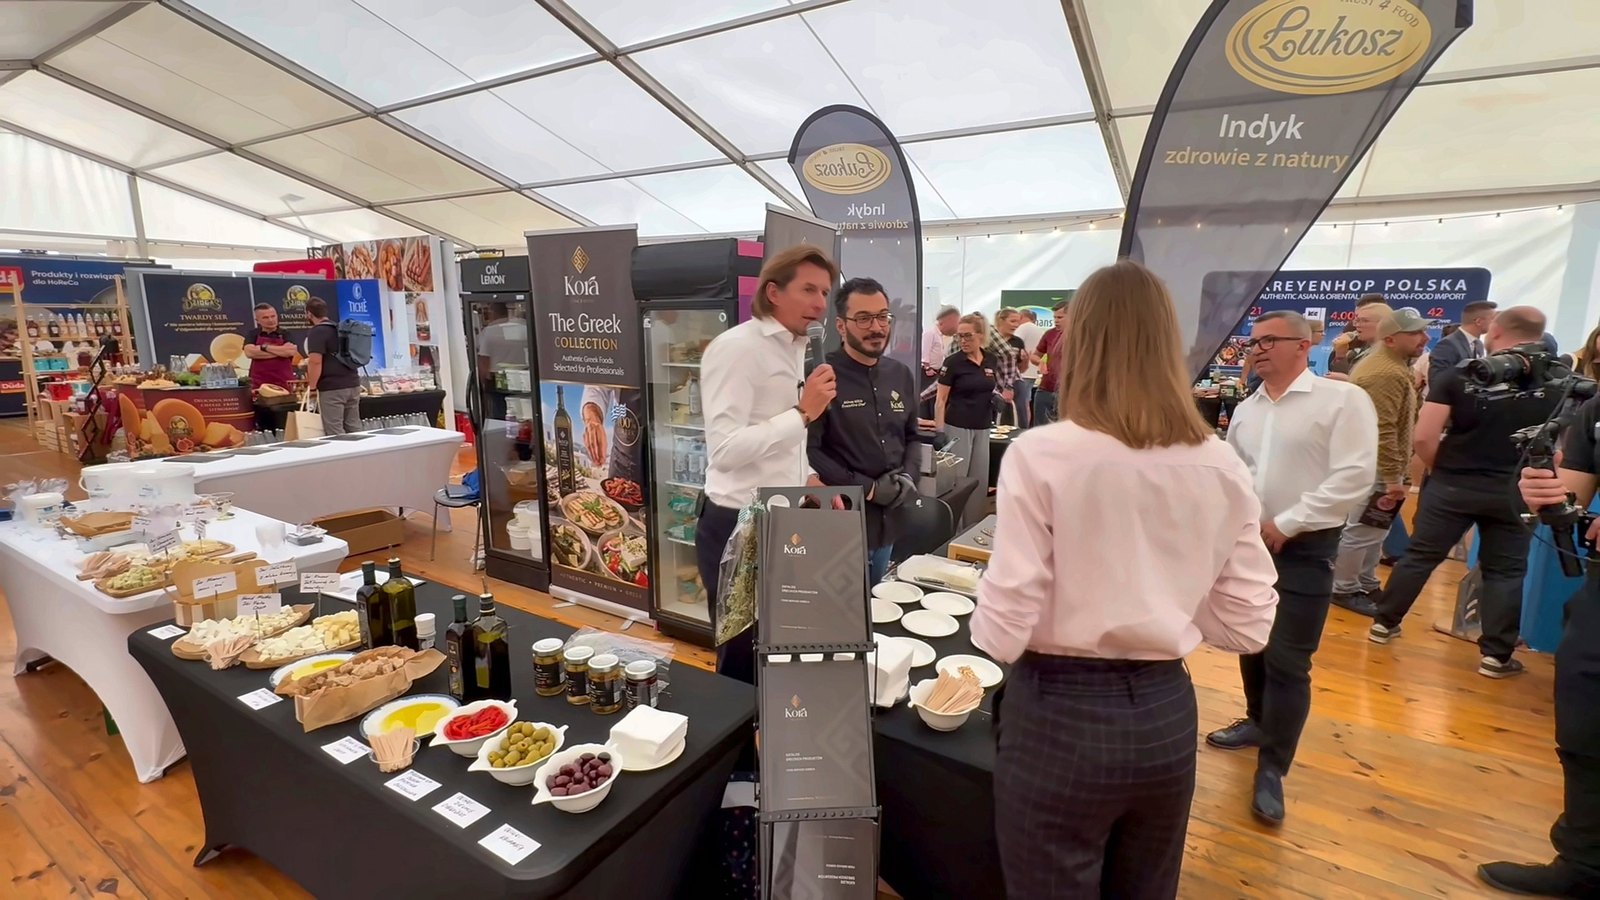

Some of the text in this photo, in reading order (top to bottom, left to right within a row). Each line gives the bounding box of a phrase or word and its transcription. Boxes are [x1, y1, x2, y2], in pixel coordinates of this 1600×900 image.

[1392, 5, 1420, 28] FOOD
[1219, 113, 1305, 145] Indyk
[1164, 146, 1349, 173] zdrowie z natury
[31, 270, 73, 280] Produkty
[485, 262, 499, 275] ON
[480, 274, 505, 285] LEMON
[1385, 279, 1467, 292] POLSKA
[1260, 292, 1298, 300] AUTHENTIC
[1298, 292, 1320, 300] ASIAN
[1325, 292, 1359, 300] ORIENTAL
[1390, 292, 1434, 300] NON-FOOD
[1434, 292, 1466, 300] IMPORT
[1427, 307, 1444, 317] 42
[549, 313, 622, 334] The Greek
[554, 336, 618, 350] COLLECTION
[562, 354, 614, 364] Authentic Greek Foods
[553, 363, 625, 376] Selected for Professionals
